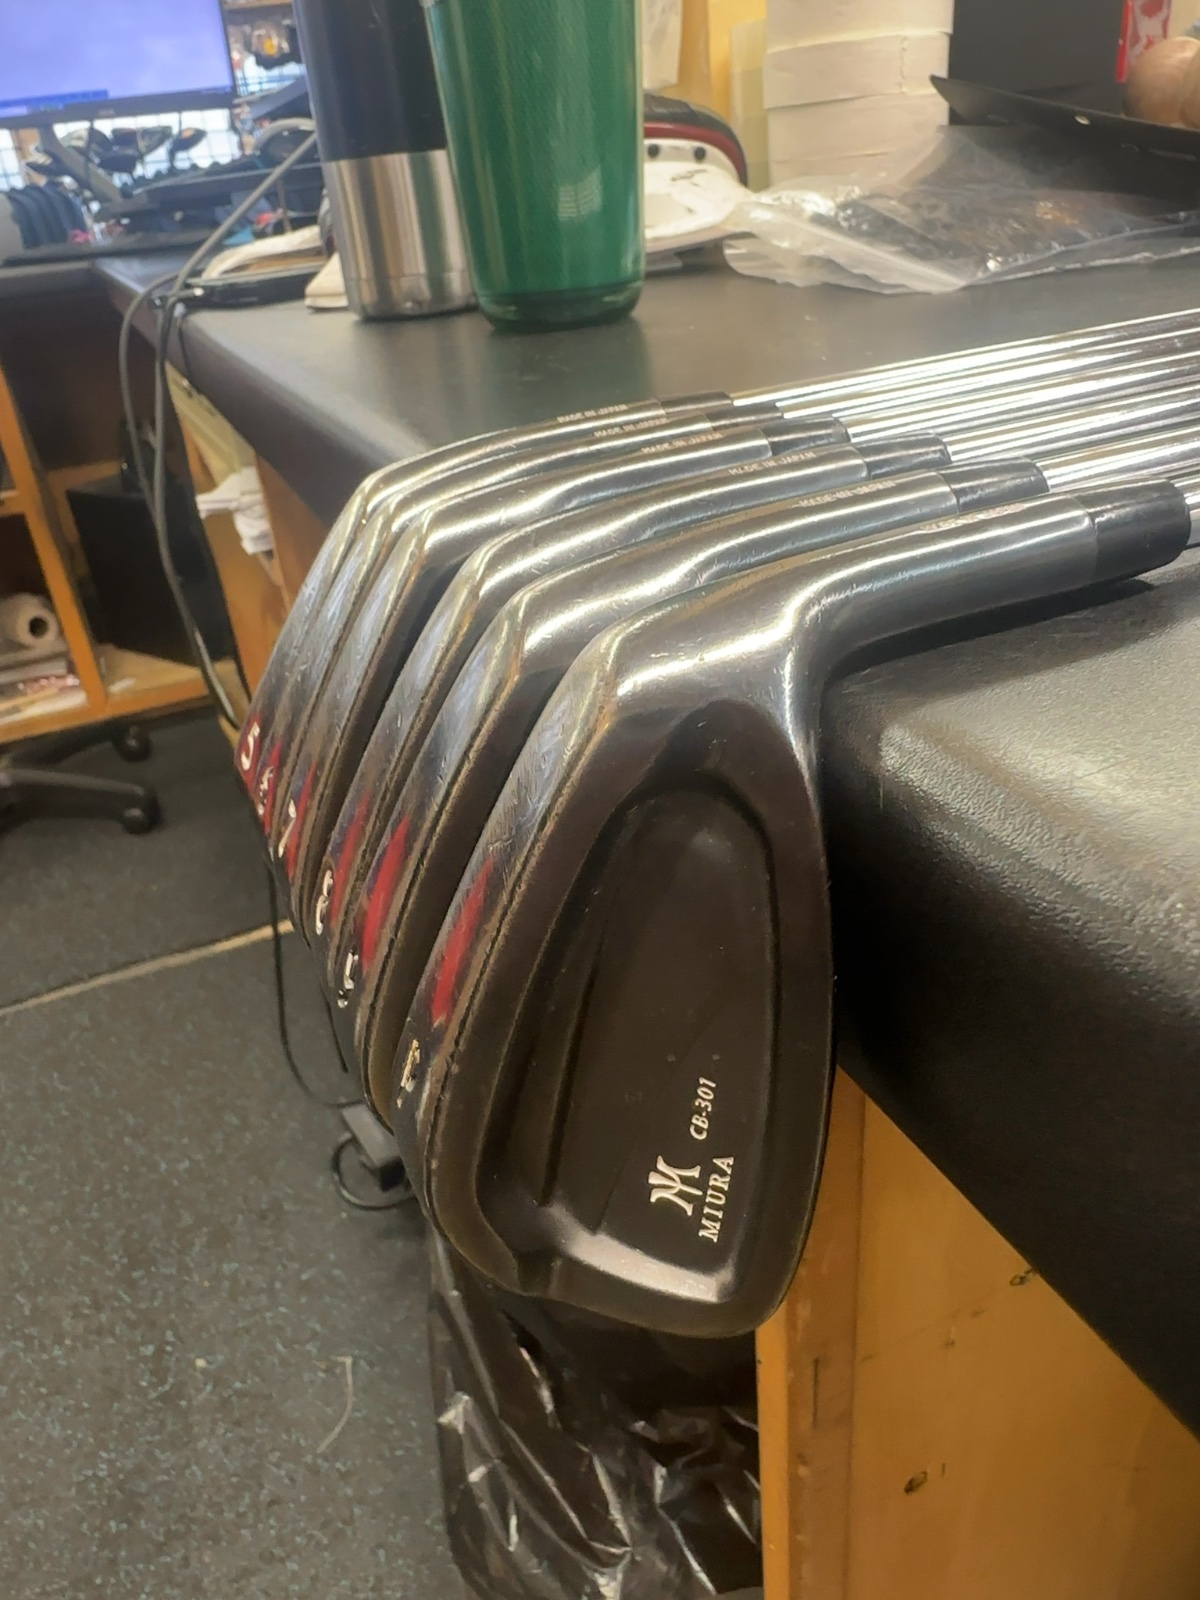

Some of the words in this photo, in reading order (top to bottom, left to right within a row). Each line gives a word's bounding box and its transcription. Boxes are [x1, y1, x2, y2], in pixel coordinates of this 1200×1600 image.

[728, 462, 763, 476] MADE
[779, 451, 816, 465] JAPAN
[690, 1076, 717, 1140] CB-301
[698, 1156, 735, 1243] MIURA
